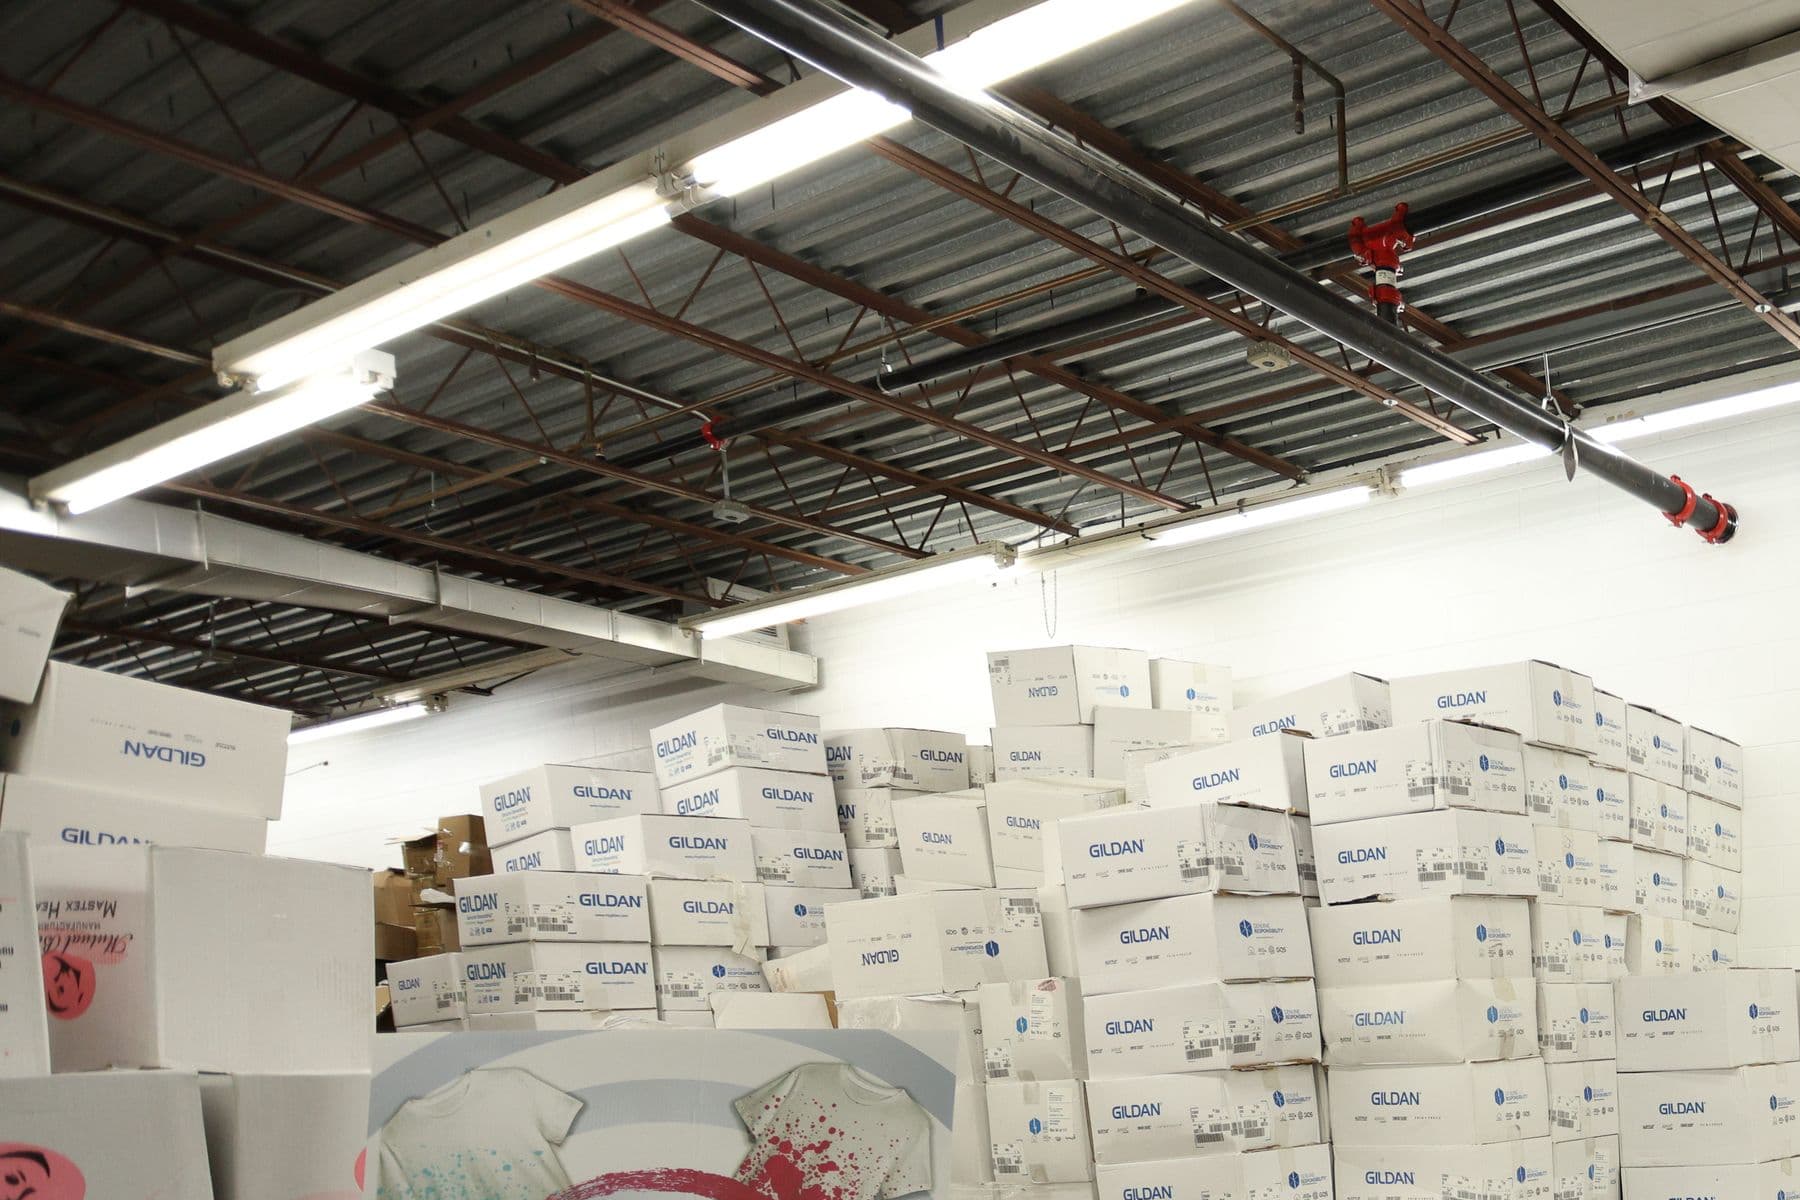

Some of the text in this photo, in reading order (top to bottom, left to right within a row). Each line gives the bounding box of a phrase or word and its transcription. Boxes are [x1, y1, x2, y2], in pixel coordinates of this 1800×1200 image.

[1435, 691, 1487, 709] GILDAN
[1252, 716, 1297, 736] GILDAN
[765, 728, 817, 745] GILDAN
[123, 740, 206, 768] GILDAN
[656, 731, 697, 761] GILDAN
[917, 748, 965, 763] GILDAN
[1329, 760, 1376, 778] GILDAN
[1191, 769, 1240, 792] GILDAN
[494, 786, 532, 811] GILDAN
[572, 784, 632, 800] GILDAN
[762, 787, 814, 801] GILDAN
[677, 791, 720, 816] GILDAN
[667, 835, 728, 849] GILDAN
[921, 832, 953, 844] GILDAN
[583, 836, 624, 859] GILDAN
[793, 848, 843, 860] GILDAN
[1088, 839, 1146, 859] GILDAN
[1338, 848, 1387, 864] GILDAN
[459, 894, 498, 913] GILDAN
[578, 892, 642, 909] GILDAN
[66, 900, 117, 918] MASTEX
[1120, 928, 1169, 944] GILDAN
[1353, 929, 1402, 944] GILDAN
[861, 948, 901, 964] GILDAN
[465, 963, 508, 981] GILDAN
[585, 960, 648, 976] GILDAN
[1355, 1012, 1405, 1027] GILDAN
[1642, 1008, 1687, 1023] GILDAN
[1105, 1019, 1152, 1036] GILDAN
[1371, 1091, 1420, 1105] GILDAN
[1112, 1104, 1162, 1120] GILDAN
[1659, 1103, 1705, 1115] GILDAN
[1365, 1170, 1415, 1184] GILDAN
